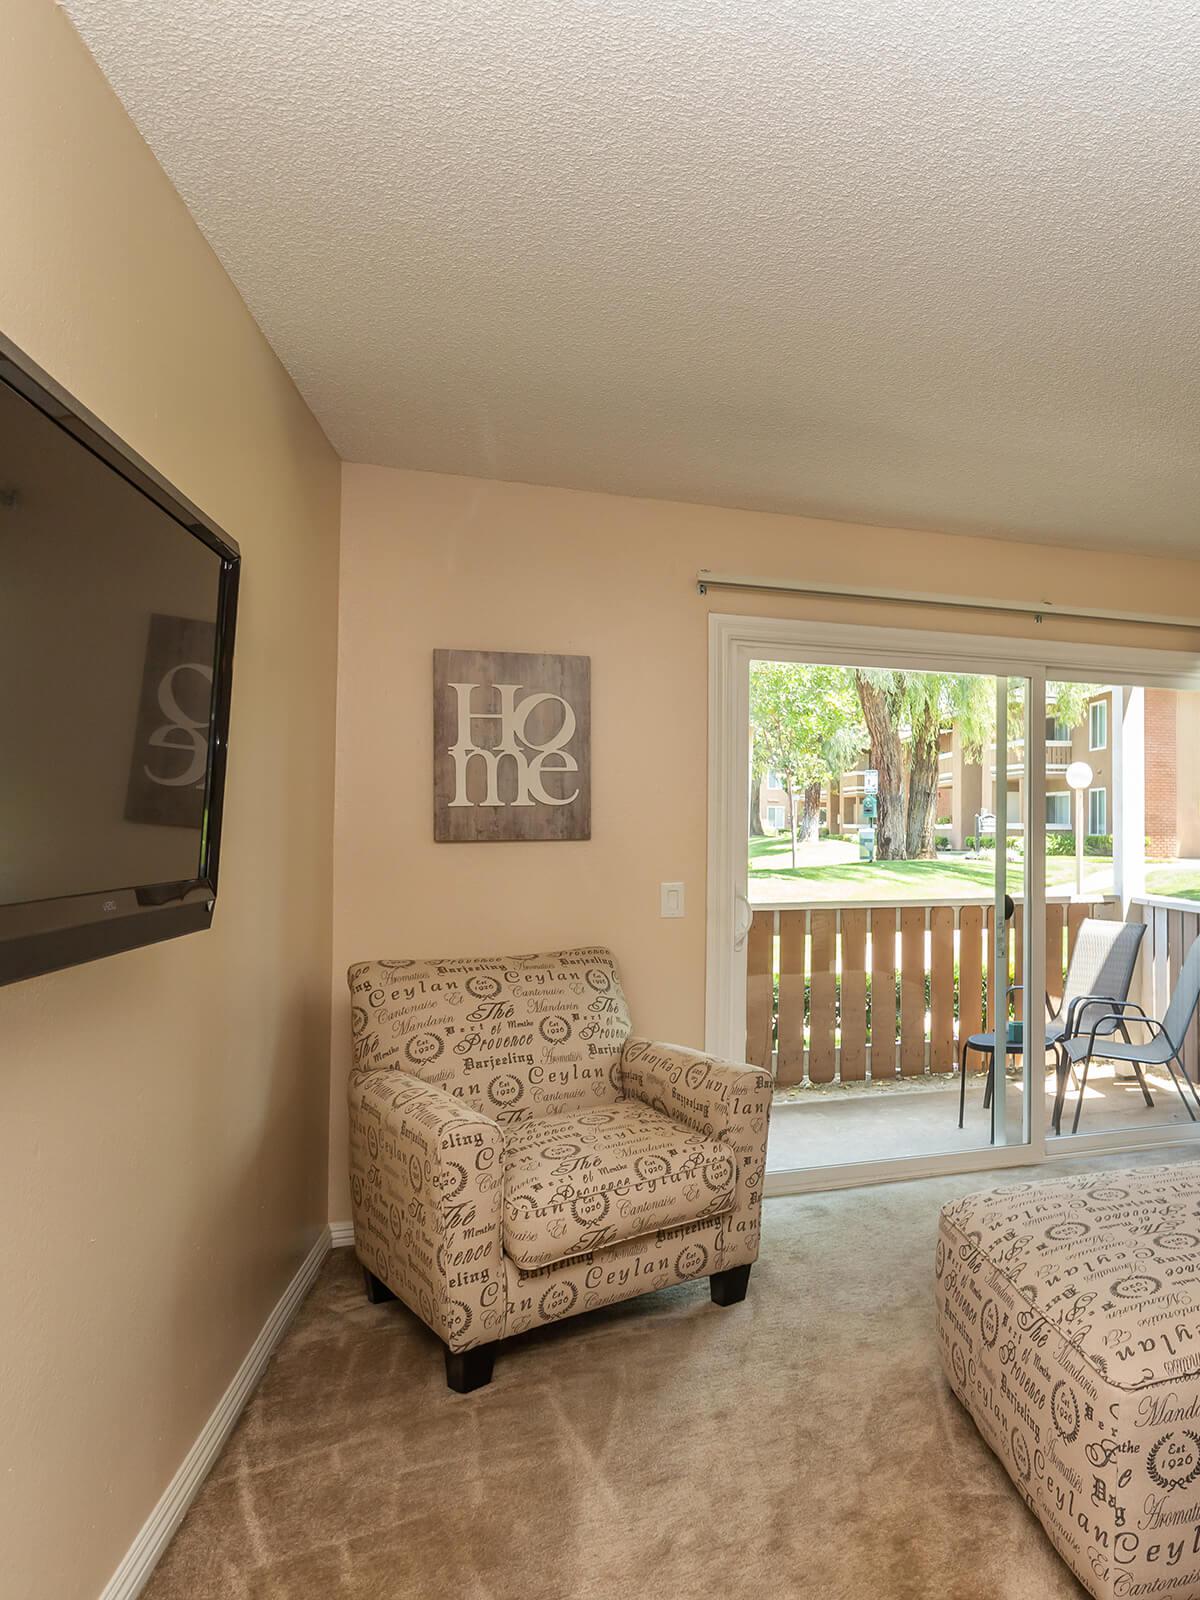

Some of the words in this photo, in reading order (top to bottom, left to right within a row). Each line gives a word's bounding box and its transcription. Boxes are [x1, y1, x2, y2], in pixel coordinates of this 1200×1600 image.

[504, 970, 580, 984] Ceylan
[369, 981, 458, 1007] Ceylan
[453, 1033, 533, 1054] Provence
[462, 1053, 534, 1075] Darjeeling
[528, 1063, 604, 1085] Ceylan
[989, 1200, 1087, 1230] Ceylan
[585, 1257, 668, 1288] Ceylan
[1046, 1248, 1154, 1286] Ceylan
[1106, 1292, 1192, 1319] Mandarin
[1000, 1340, 1046, 1410] Provence
[968, 1358, 1008, 1432] Ceylan
[1001, 1372, 1040, 1443] Darjeeling
[1161, 1454, 1193, 1469] 1926
[1168, 1444, 1186, 1454] Est
[1034, 1449, 1109, 1548] Ceylan
